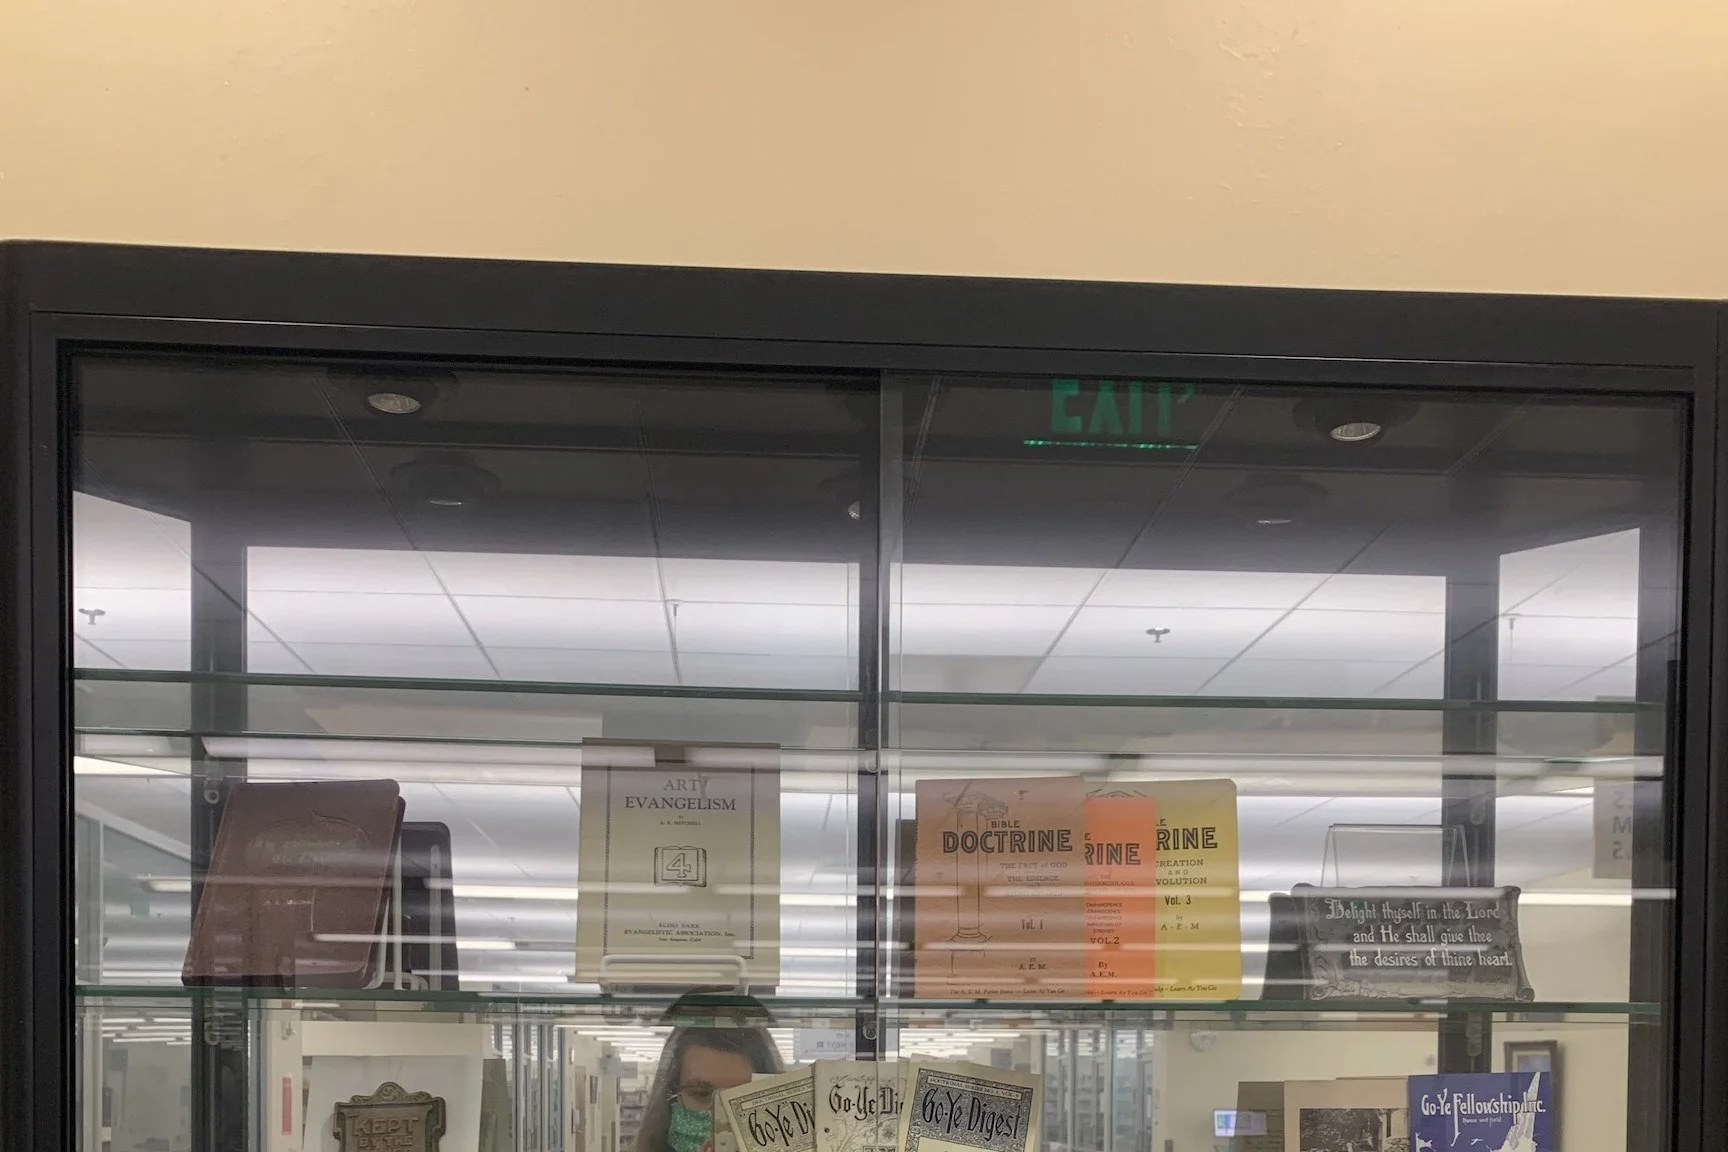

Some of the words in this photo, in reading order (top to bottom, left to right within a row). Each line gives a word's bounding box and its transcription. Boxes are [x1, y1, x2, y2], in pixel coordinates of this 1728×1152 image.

[624, 796, 737, 811] EVANGELISM
[991, 820, 1021, 829] BIBLE
[942, 829, 1073, 854] DOCTRINE
[666, 852, 692, 879] 4
[1164, 895, 1182, 906] Vol.
[1185, 894, 1192, 906] 3
[1324, 897, 1377, 925] Delight
[1381, 898, 1421, 925] thyself
[1426, 901, 1438, 920] in
[1442, 901, 1461, 920] the
[1465, 900, 1500, 920] Lord
[1352, 926, 1375, 944] and
[1379, 925, 1400, 944] He
[1405, 926, 1436, 944] shall
[1440, 927, 1465, 946] give
[1468, 925, 1493, 943] thee
[1349, 948, 1369, 967] the
[1373, 948, 1419, 967] desires
[1424, 947, 1438, 967] of
[1442, 949, 1473, 967] thine
[1478, 948, 1514, 967] heart.
[929, 1077, 964, 1088] DOCTRINAL
[828, 1083, 877, 1121] Go-Ye
[1420, 1087, 1452, 1116] Go-Ye
[1522, 1091, 1547, 1114] Inc.
[922, 1087, 963, 1134] Go-Ye
[966, 1096, 1021, 1143] Digest
[358, 1136, 382, 1148] BY
[382, 1134, 413, 1147] THE
